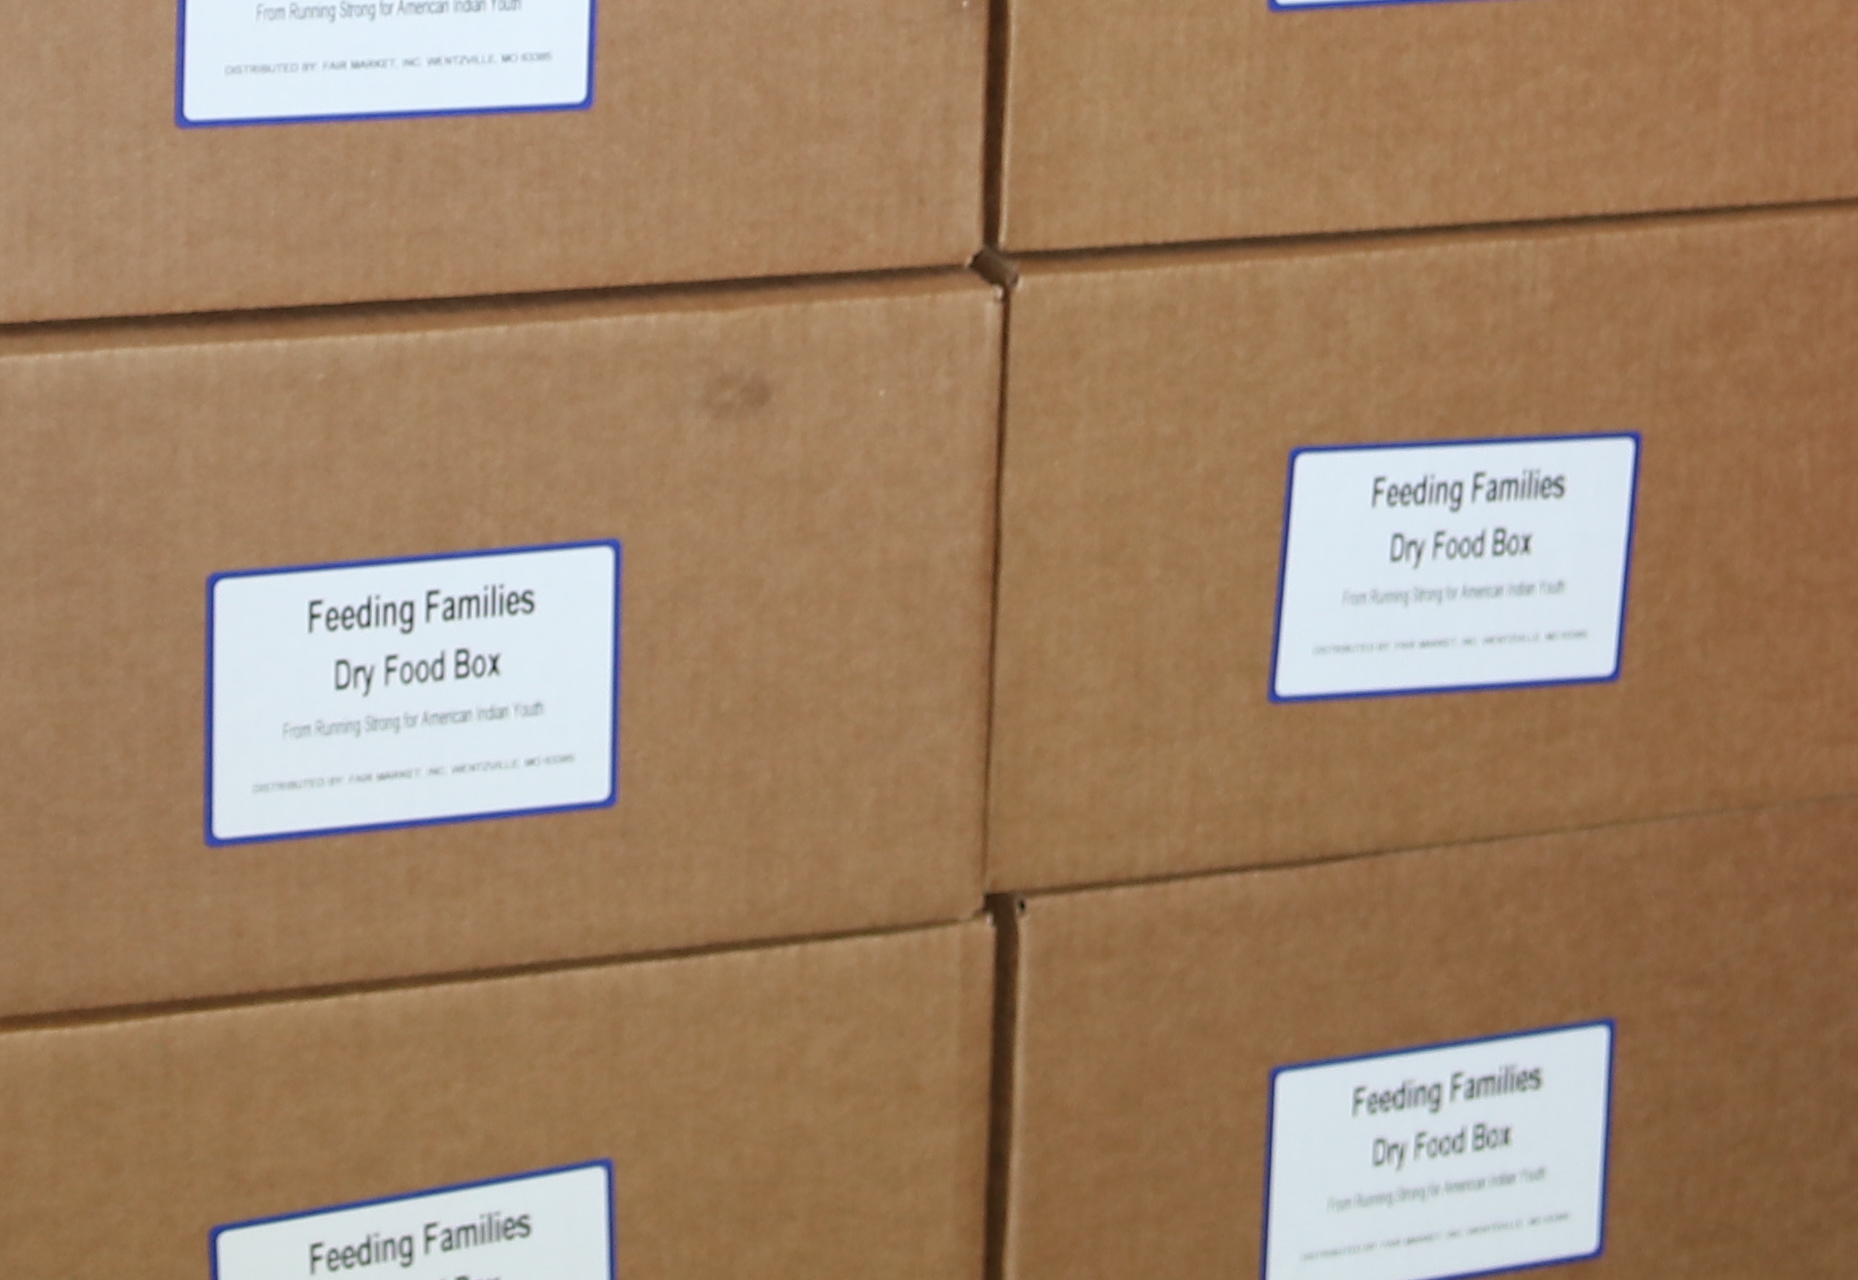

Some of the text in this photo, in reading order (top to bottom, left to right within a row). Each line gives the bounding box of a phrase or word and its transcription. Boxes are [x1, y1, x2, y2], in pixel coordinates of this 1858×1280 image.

[256, 4, 286, 21] From
[289, 3, 336, 23] Running
[340, 1, 376, 21] Strong
[379, 0, 394, 16] for
[397, 0, 449, 14] American
[1372, 470, 1566, 512] Feeding Families
[1390, 527, 1532, 569] Dry Food Box
[308, 584, 535, 633] Feeding Families
[335, 648, 500, 697] Dry Food Box
[1352, 1066, 1543, 1116] Feeding Families
[1372, 1124, 1511, 1170] Dry Food Box
[309, 1212, 532, 1275] Feeding Families
